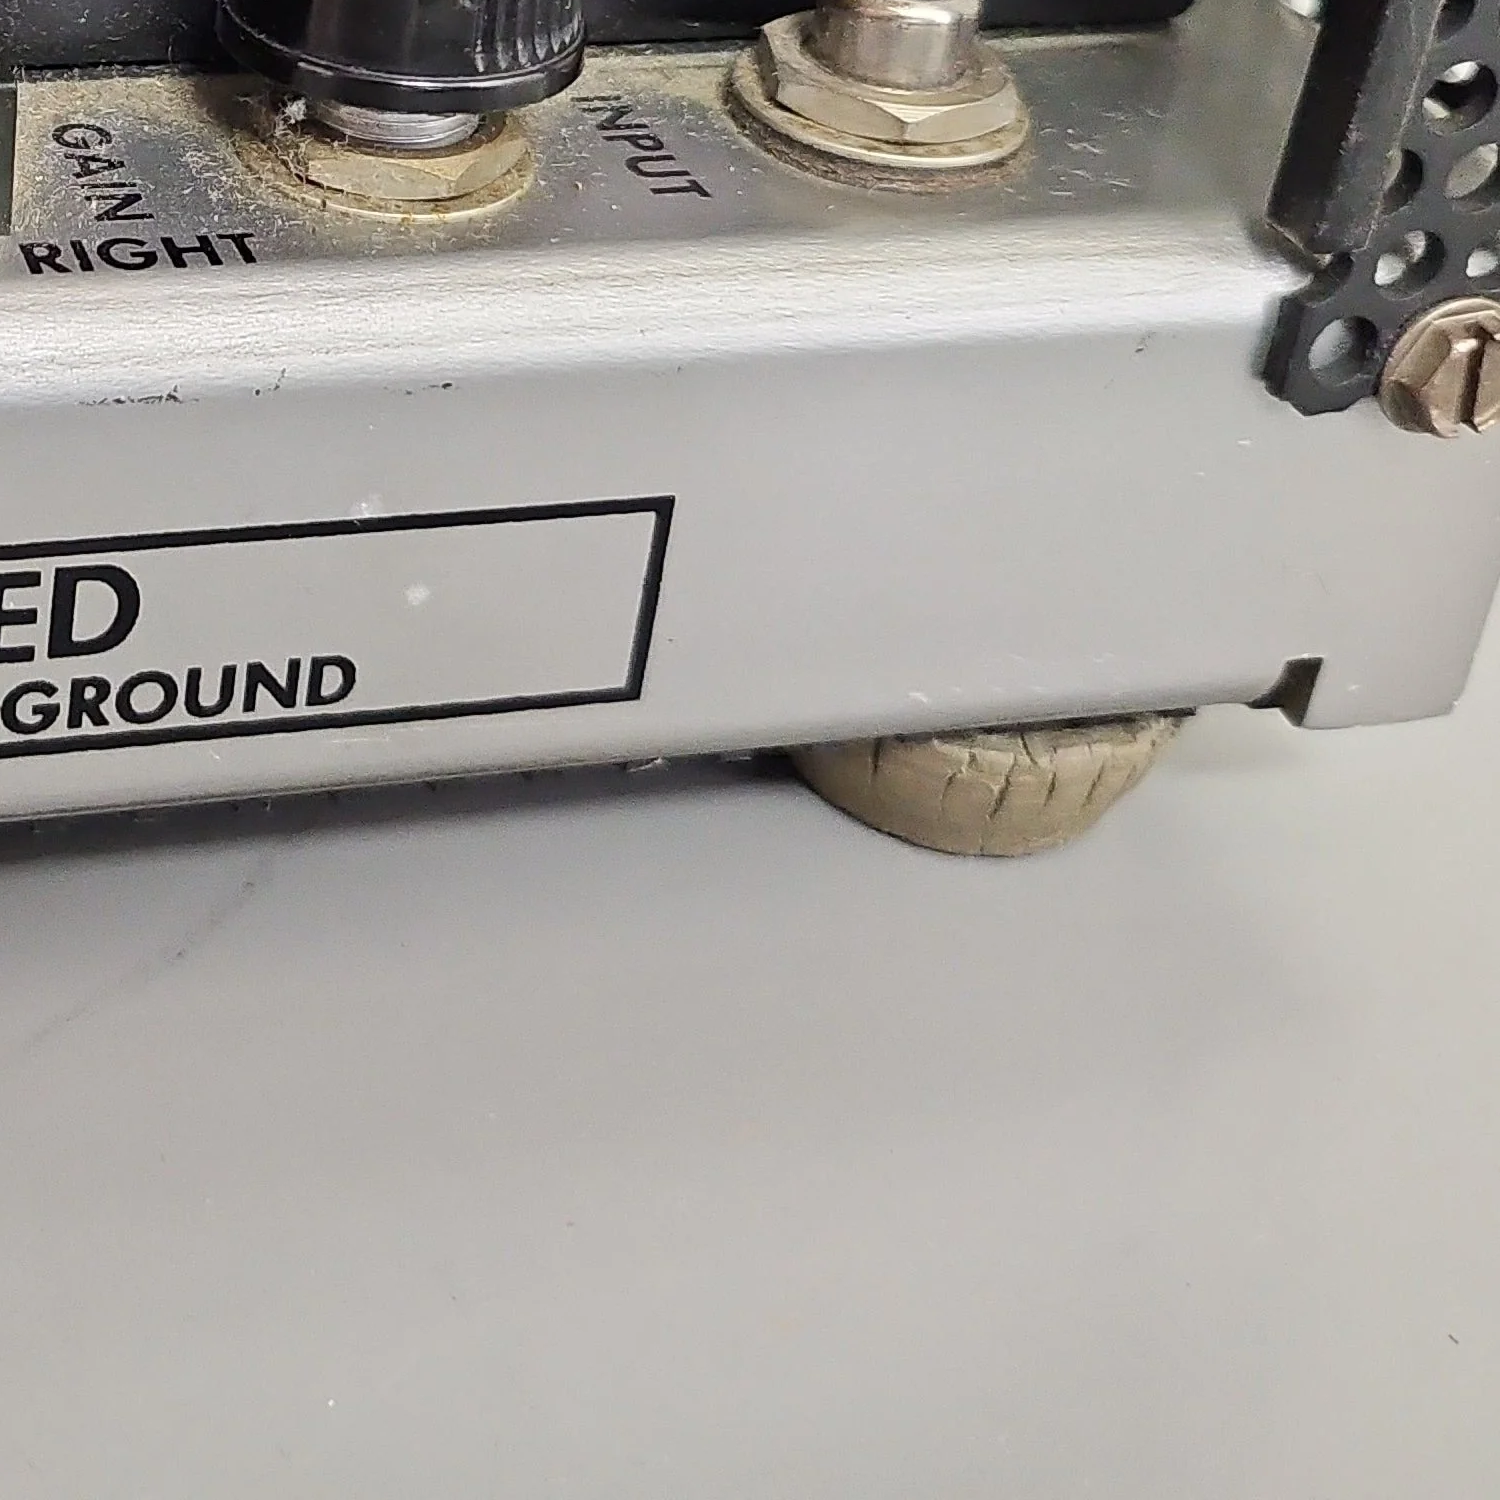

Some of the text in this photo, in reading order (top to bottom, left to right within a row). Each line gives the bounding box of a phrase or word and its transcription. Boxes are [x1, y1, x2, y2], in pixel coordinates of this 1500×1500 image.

[51, 123, 155, 221] GAIN
[570, 95, 713, 198] INPUT
[18, 232, 258, 275] RIGHT
[0, 655, 357, 736] GROUND
